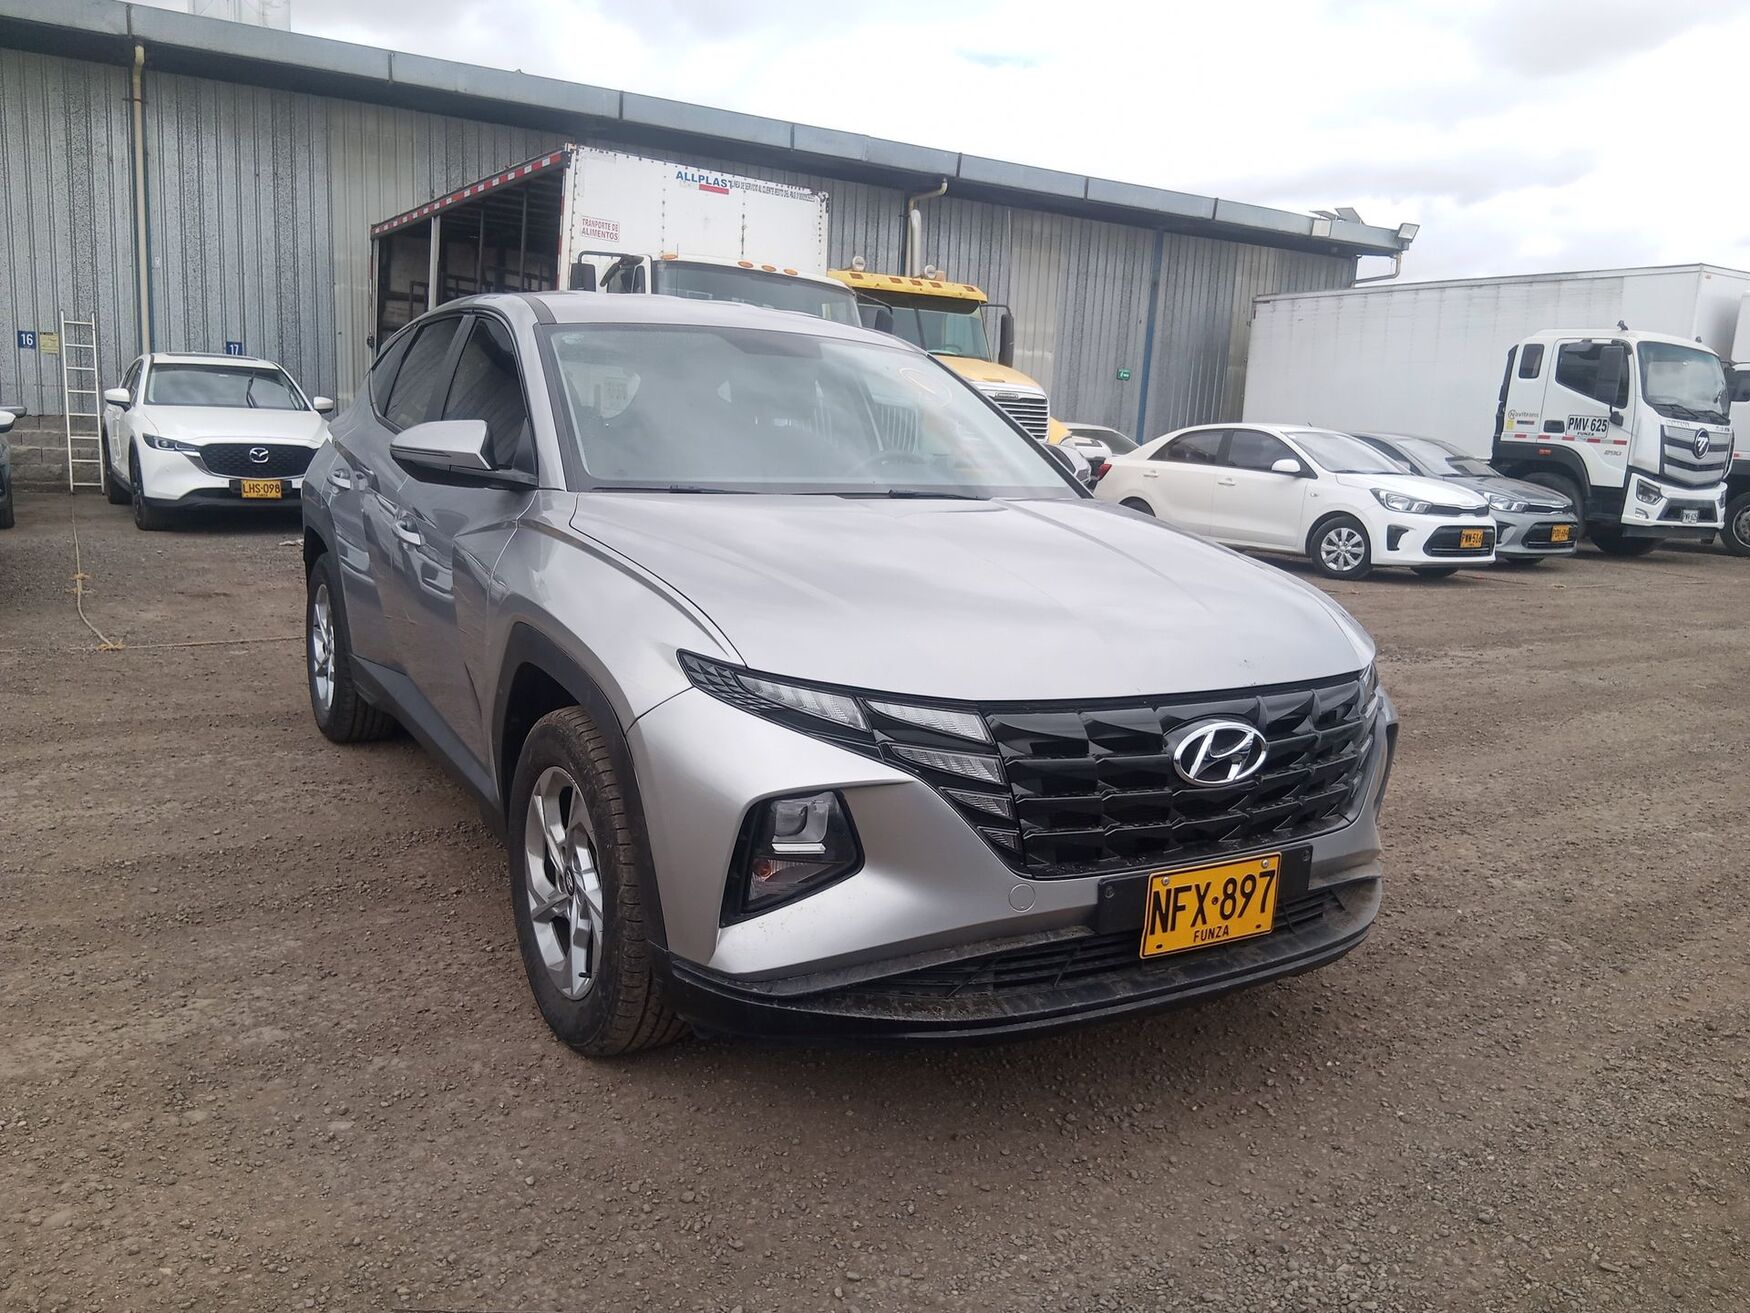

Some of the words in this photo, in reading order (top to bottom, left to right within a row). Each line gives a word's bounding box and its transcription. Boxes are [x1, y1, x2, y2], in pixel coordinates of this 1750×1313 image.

[676, 171, 733, 189] ALLPLAST
[581, 227, 619, 240] ALIMENTOS
[20, 333, 34, 346] 16
[229, 344, 239, 355] 17
[1193, 925, 1230, 943] FUNZA
